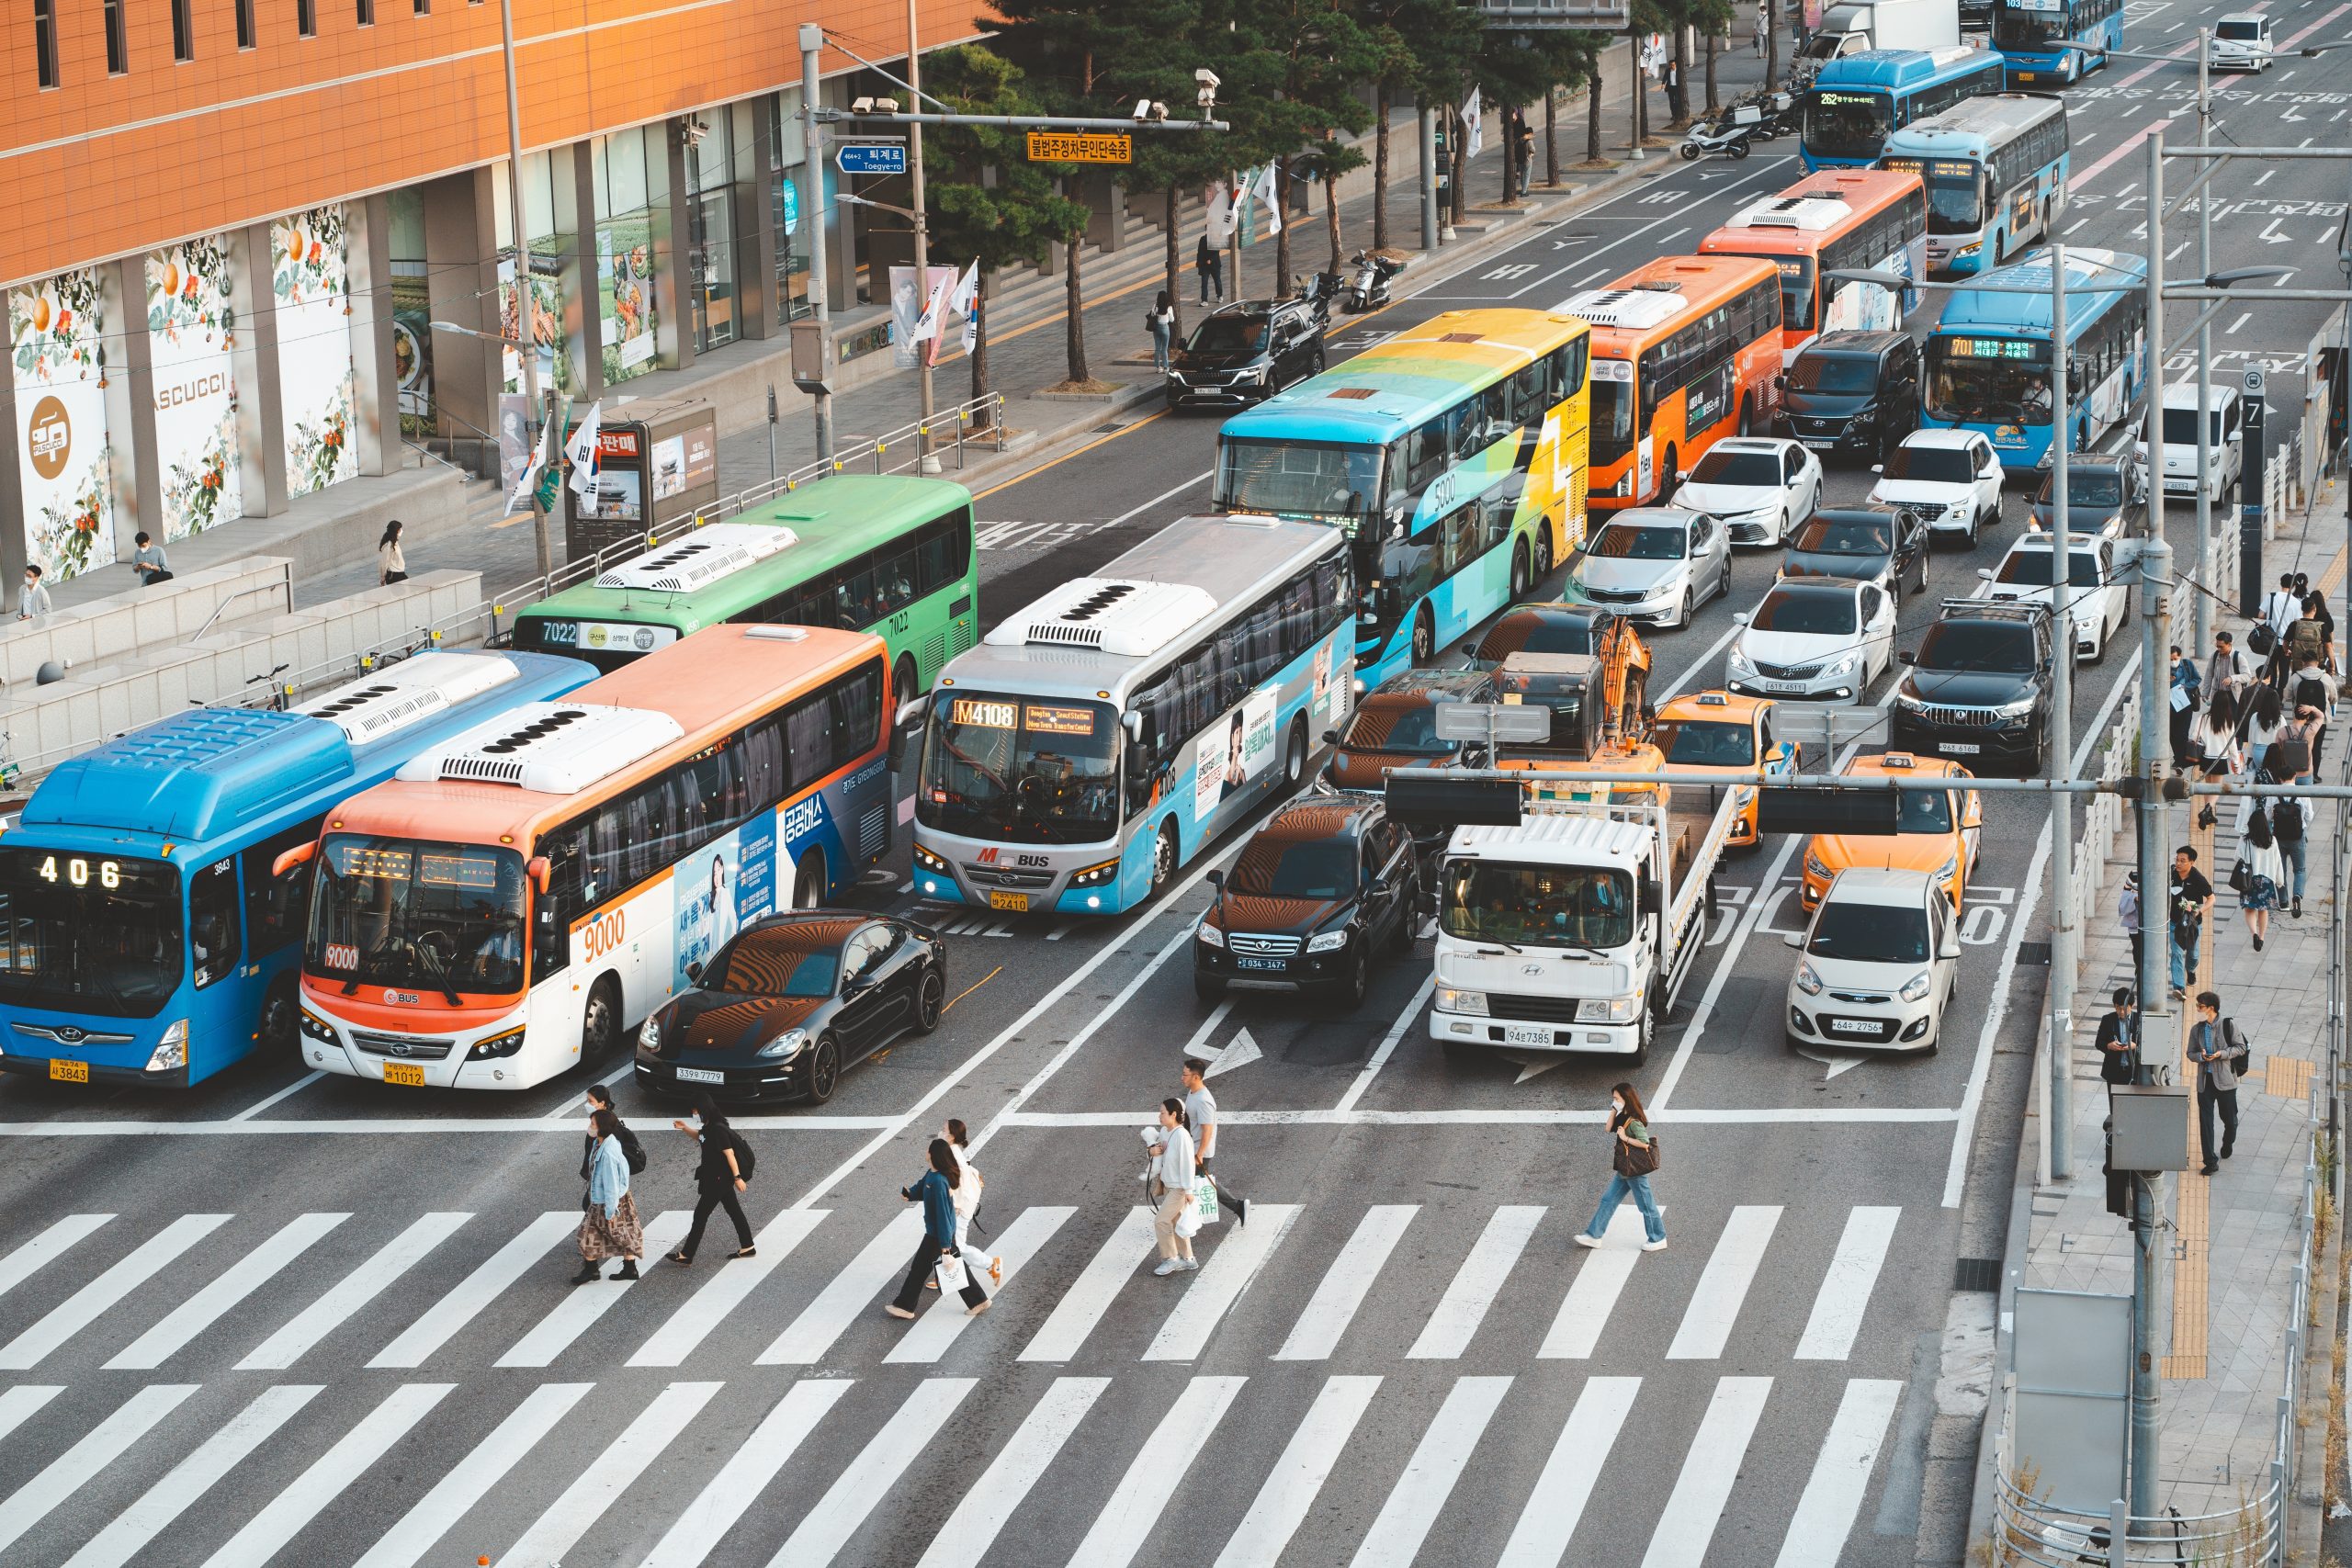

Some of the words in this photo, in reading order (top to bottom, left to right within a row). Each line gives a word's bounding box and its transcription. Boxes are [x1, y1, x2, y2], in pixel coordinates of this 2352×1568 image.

[1821, 94, 1837, 105] 262
[869, 149, 901, 161] 퇴계로
[1033, 139, 1127, 160] 불법주정차무인단속중
[864, 162, 901, 171] Toegye-ro
[1953, 339, 1973, 355] 701
[2247, 403, 2260, 422] 7
[33, 438, 62, 456] PASCUCCI
[1640, 454, 1652, 476] flex
[1435, 473, 1455, 513] 5000
[543, 622, 577, 642] 7022
[888, 611, 909, 637] 7022
[958, 702, 1012, 727] M4108
[842, 776, 856, 794] 경기도
[1149, 766, 1176, 808] M4108
[786, 795, 823, 844] 공공버스
[977, 847, 1000, 863] M
[1017, 854, 1049, 867] BUS
[214, 859, 231, 875] 3843
[585, 908, 625, 963] 9000
[328, 945, 356, 970] 9000
[398, 993, 419, 1004] BUS
[1856, 1021, 1879, 1031] 2756
[701, 1071, 721, 1081] 7779
